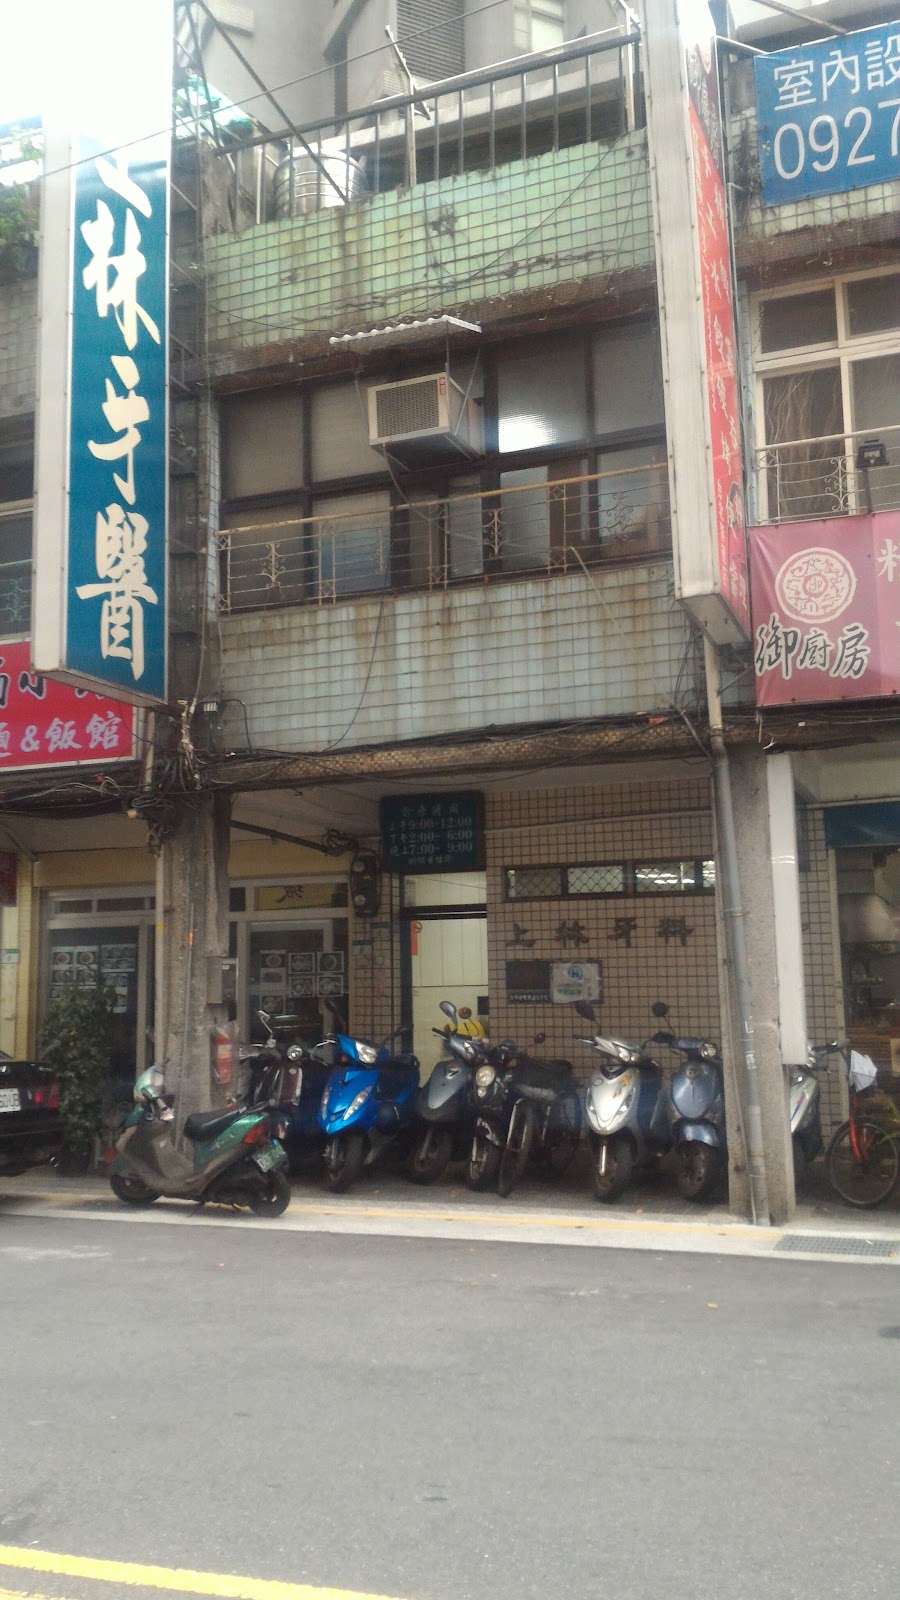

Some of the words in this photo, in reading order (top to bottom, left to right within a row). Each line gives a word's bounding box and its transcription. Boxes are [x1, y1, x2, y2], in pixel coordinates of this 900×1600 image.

[773, 97, 900, 180] 0927
[754, 612, 871, 680] 御廚房
